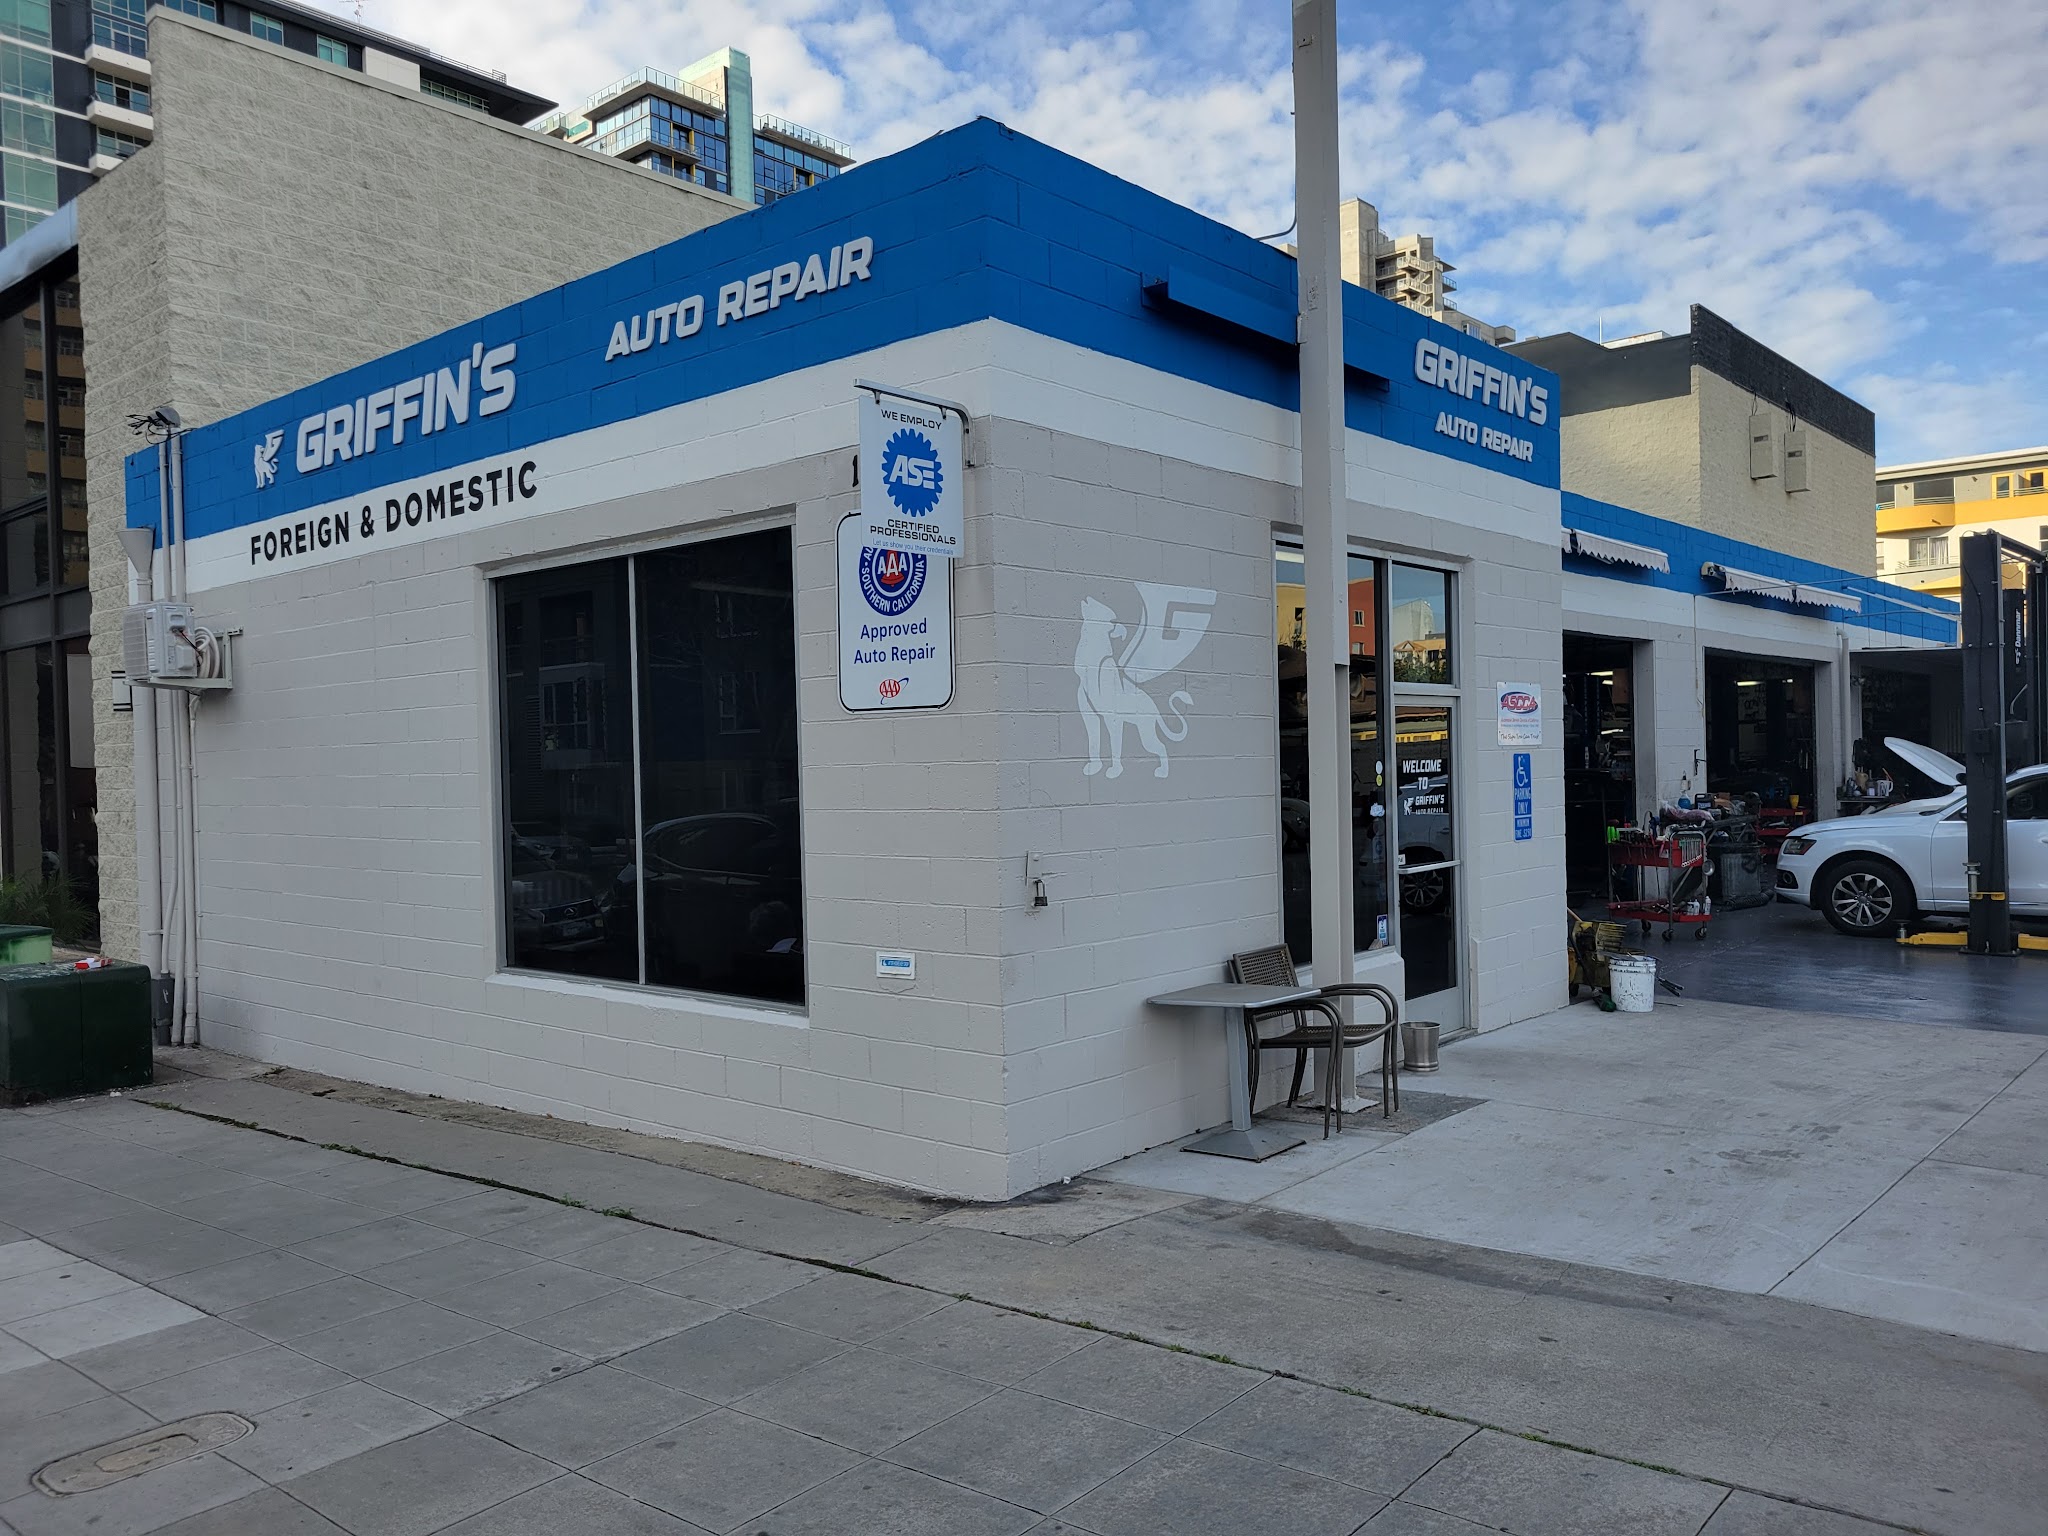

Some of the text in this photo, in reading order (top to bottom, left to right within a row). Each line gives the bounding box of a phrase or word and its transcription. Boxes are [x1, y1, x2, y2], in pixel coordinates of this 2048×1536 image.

[605, 236, 873, 361] AUTO REPAIR
[1415, 338, 1548, 426] GRIFFIN'S
[296, 342, 516, 473] GRIFFIN'S
[881, 409, 942, 430] WE EMPLOY
[1435, 412, 1533, 462] AUTO REPAIR
[889, 454, 935, 490] ASE
[250, 460, 538, 565] FOREIGN & DOMESTIC
[870, 525, 956, 545] PROFESSIONALS
[887, 519, 940, 534] CERTIFIED
[877, 553, 908, 577] AAA
[862, 560, 925, 612] SOUTHERN CALIFORNIA
[860, 618, 928, 643] Approved
[854, 643, 936, 664] Auto Repair
[1403, 759, 1442, 773] WELCOME
[1418, 777, 1428, 790] TO
[1415, 794, 1444, 805] GRIFFIN'S
